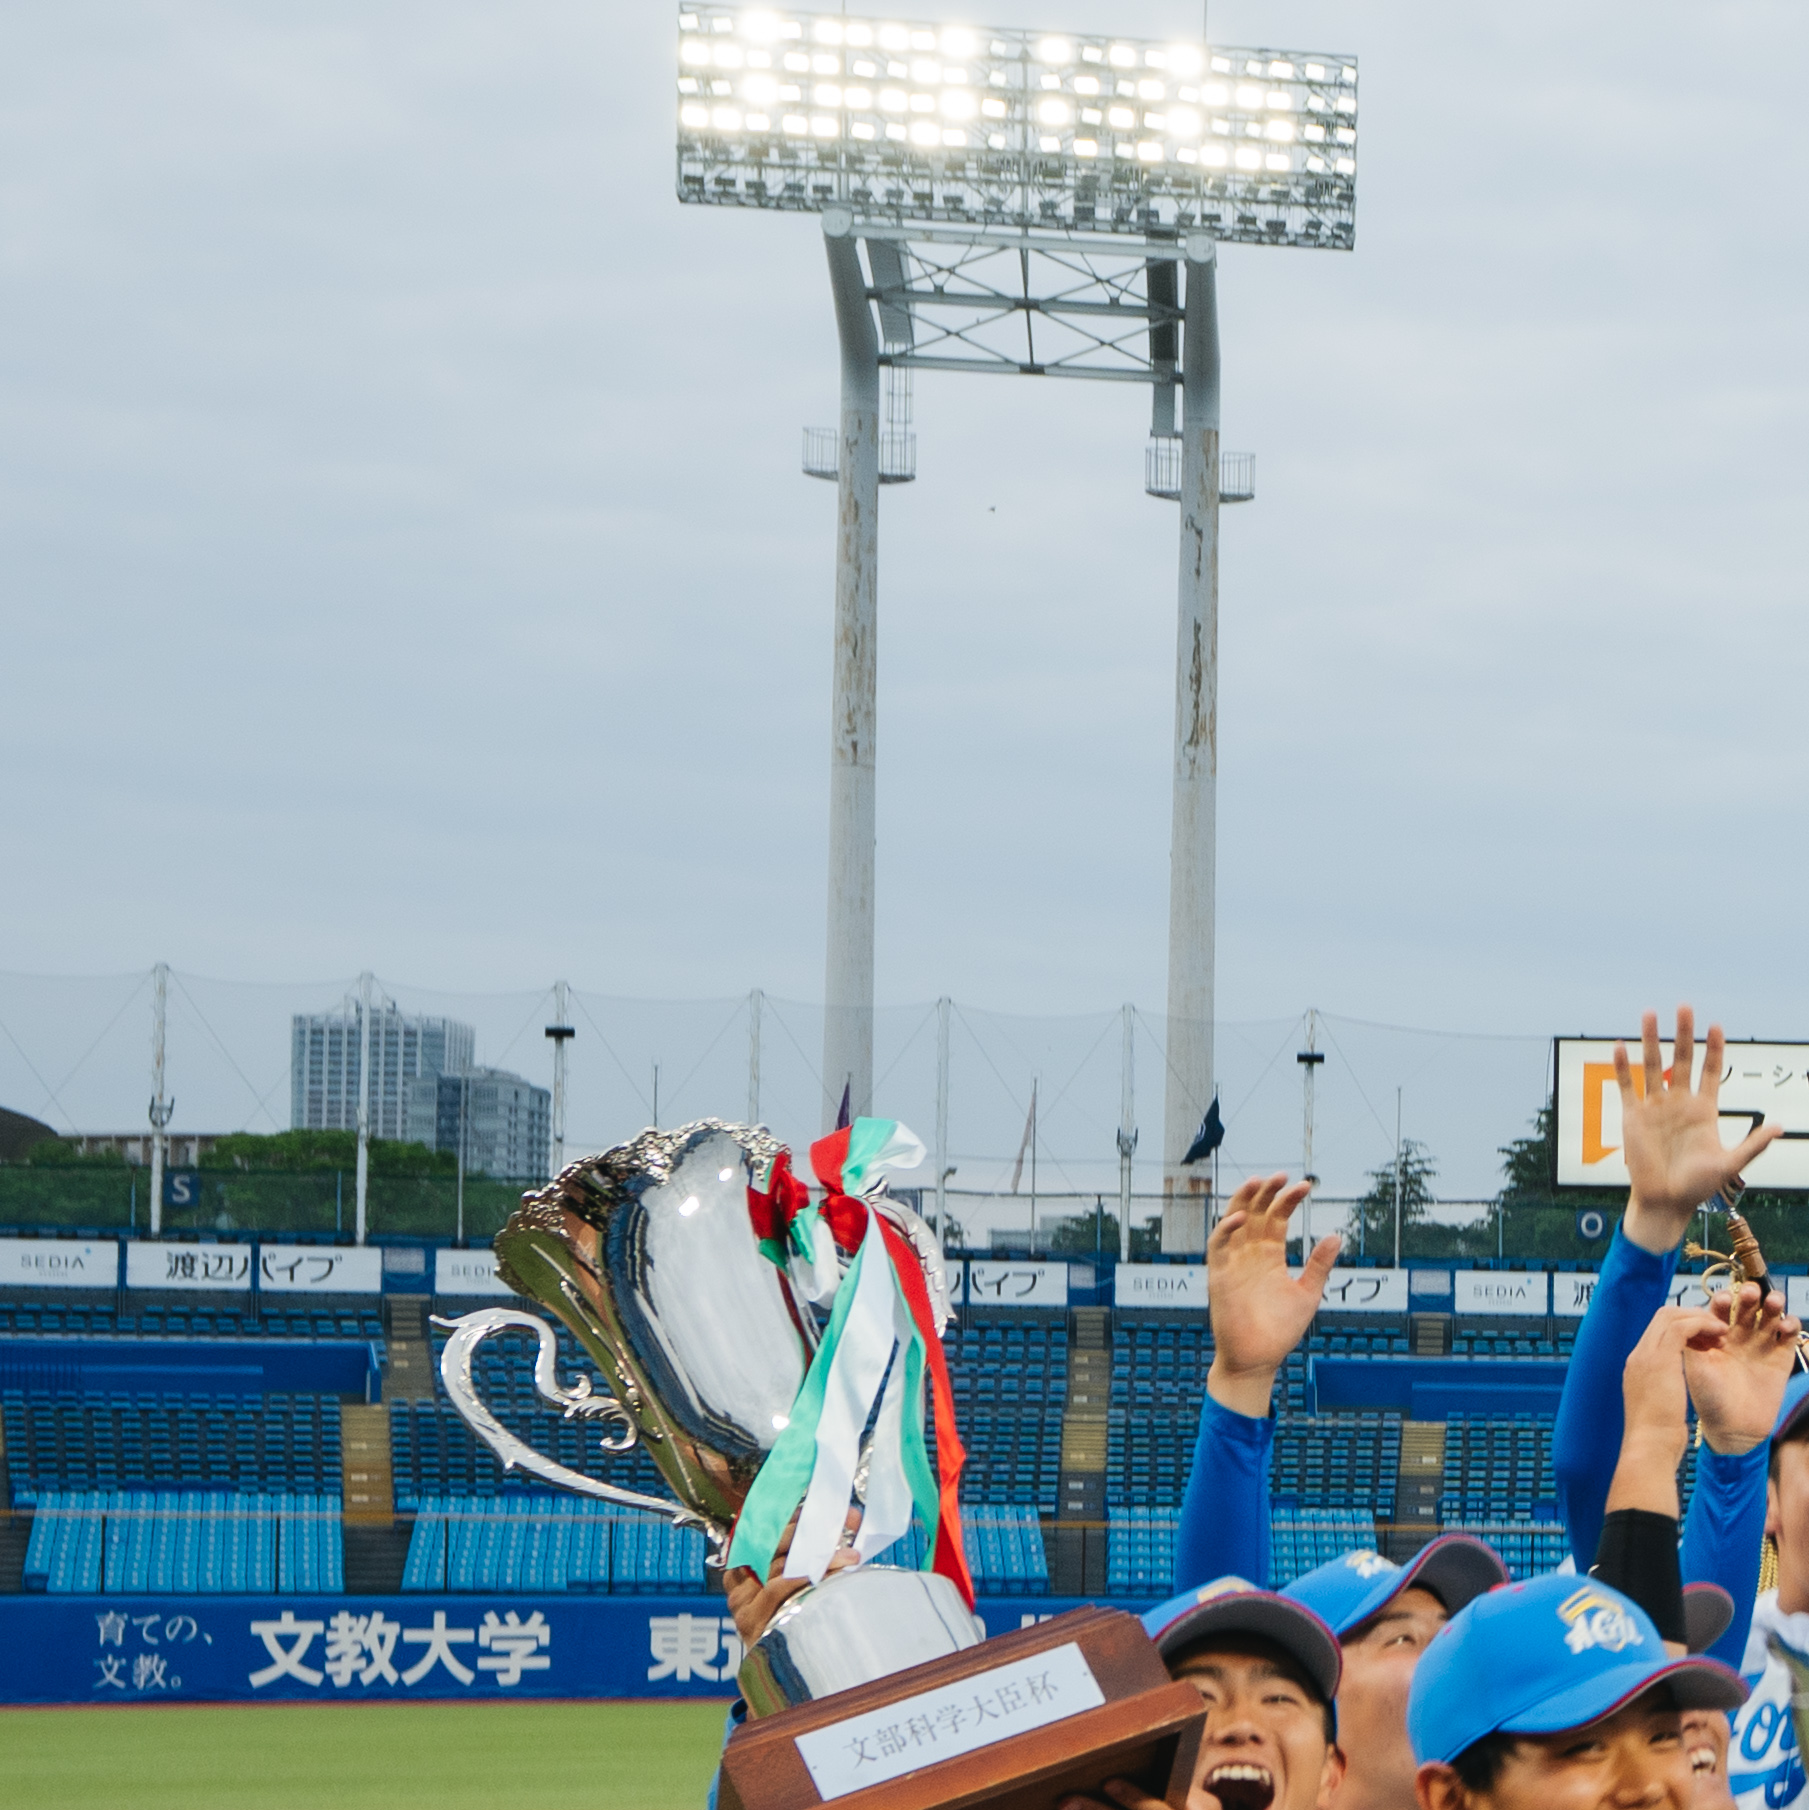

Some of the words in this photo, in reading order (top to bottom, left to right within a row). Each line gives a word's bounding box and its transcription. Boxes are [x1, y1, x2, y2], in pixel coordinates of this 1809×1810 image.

[172, 1174, 191, 1203] S
[20, 1253, 85, 1270] SEDIA
[451, 1264, 491, 1278] SEDI
[950, 1267, 1045, 1299] パイプ
[1133, 1278, 1188, 1292] SEDIA
[1473, 1285, 1526, 1299] SEDIA
[95, 1611, 214, 1648] 育ての、
[248, 1611, 550, 1687] 文教大学
[94, 1654, 184, 1690] 文教。
[843, 1669, 1060, 1770] 文部科学大臣杯
